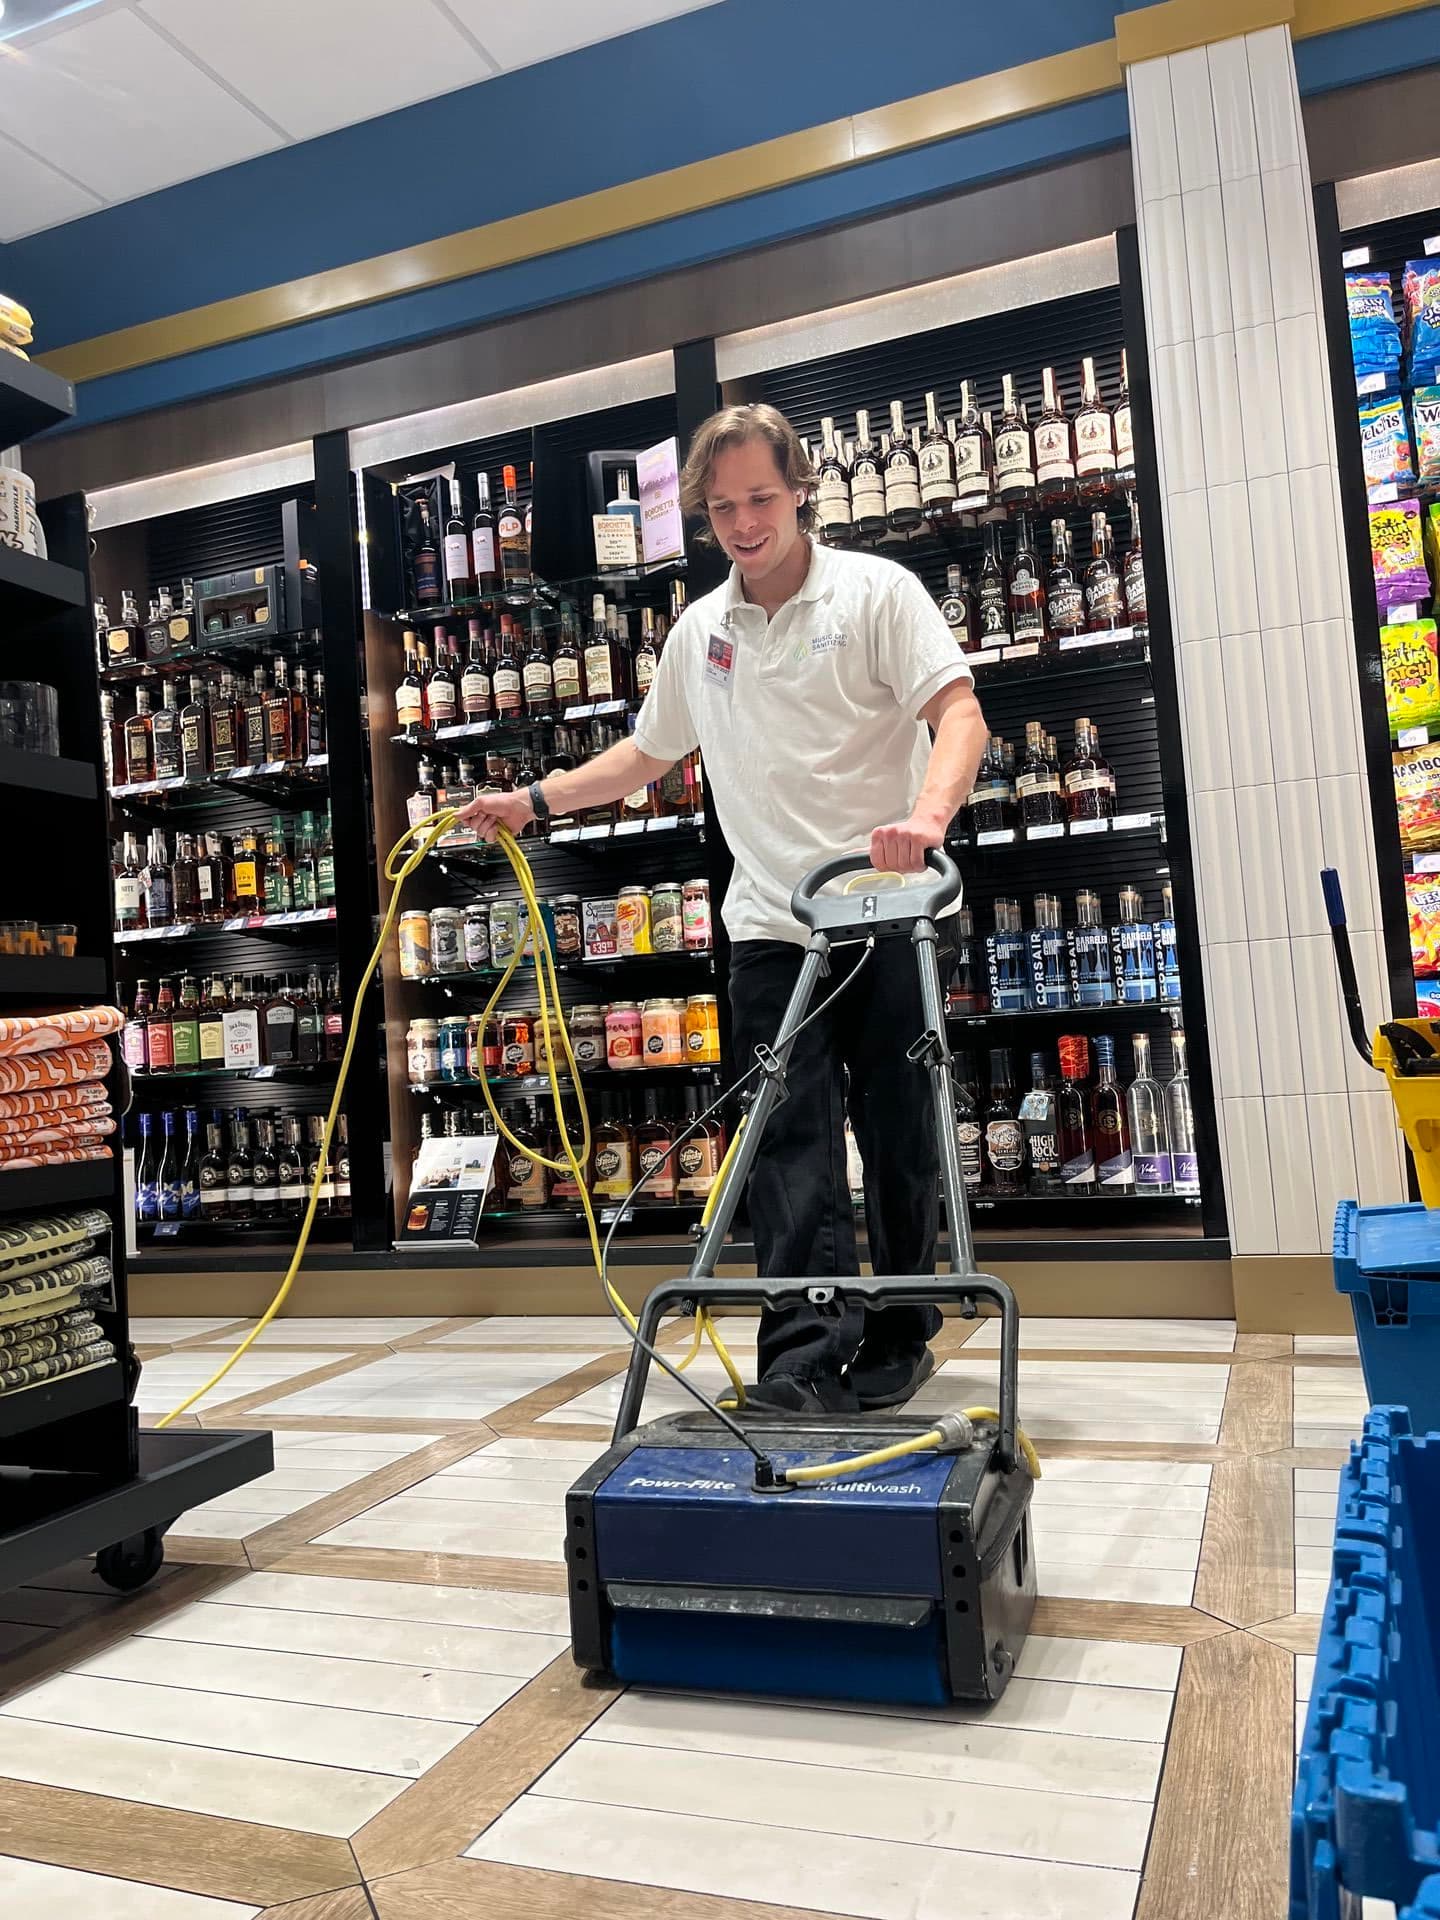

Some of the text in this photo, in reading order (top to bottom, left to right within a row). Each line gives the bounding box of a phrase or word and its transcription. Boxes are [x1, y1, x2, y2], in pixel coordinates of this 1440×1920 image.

[500, 522, 518, 533] PLP
[986, 937, 1001, 1009] CORSAIR
[1031, 933, 1047, 1006] CORSAIR
[1067, 930, 1080, 1003] CORSAIR
[1111, 926, 1125, 1000] CORSAIR
[1153, 922, 1167, 1000] CORSAIR
[1029, 1135, 1054, 1147] HIGH
[1032, 1145, 1059, 1158] ROCK
[628, 1477, 922, 1495] Powr-Flite Multiwash
